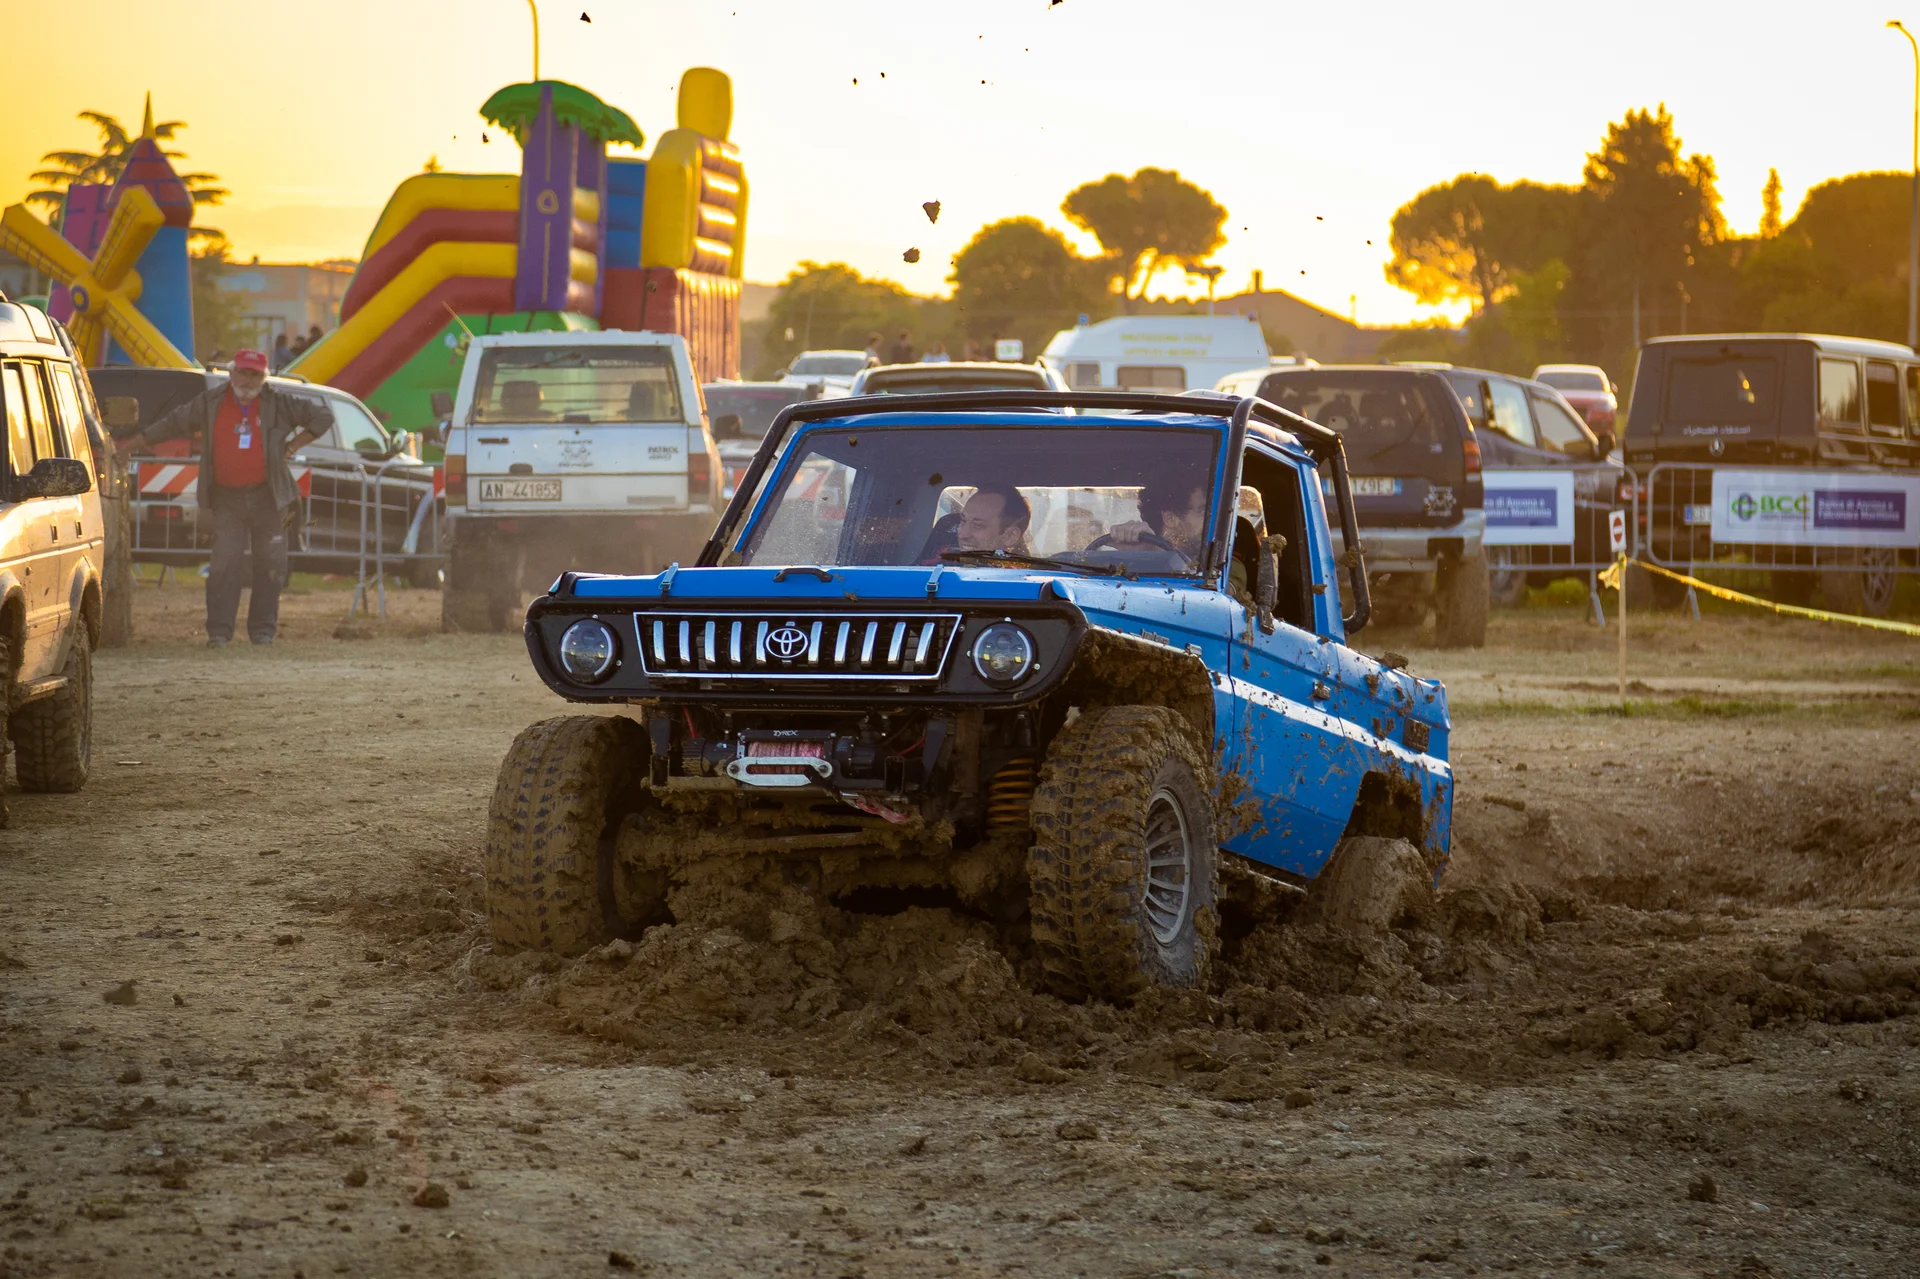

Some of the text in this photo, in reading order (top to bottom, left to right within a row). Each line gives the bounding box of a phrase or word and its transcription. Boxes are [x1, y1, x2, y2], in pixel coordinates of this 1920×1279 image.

[647, 446, 678, 454] PATROL
[484, 483, 559, 498] AN 441853
[1760, 495, 1811, 513] BCC
